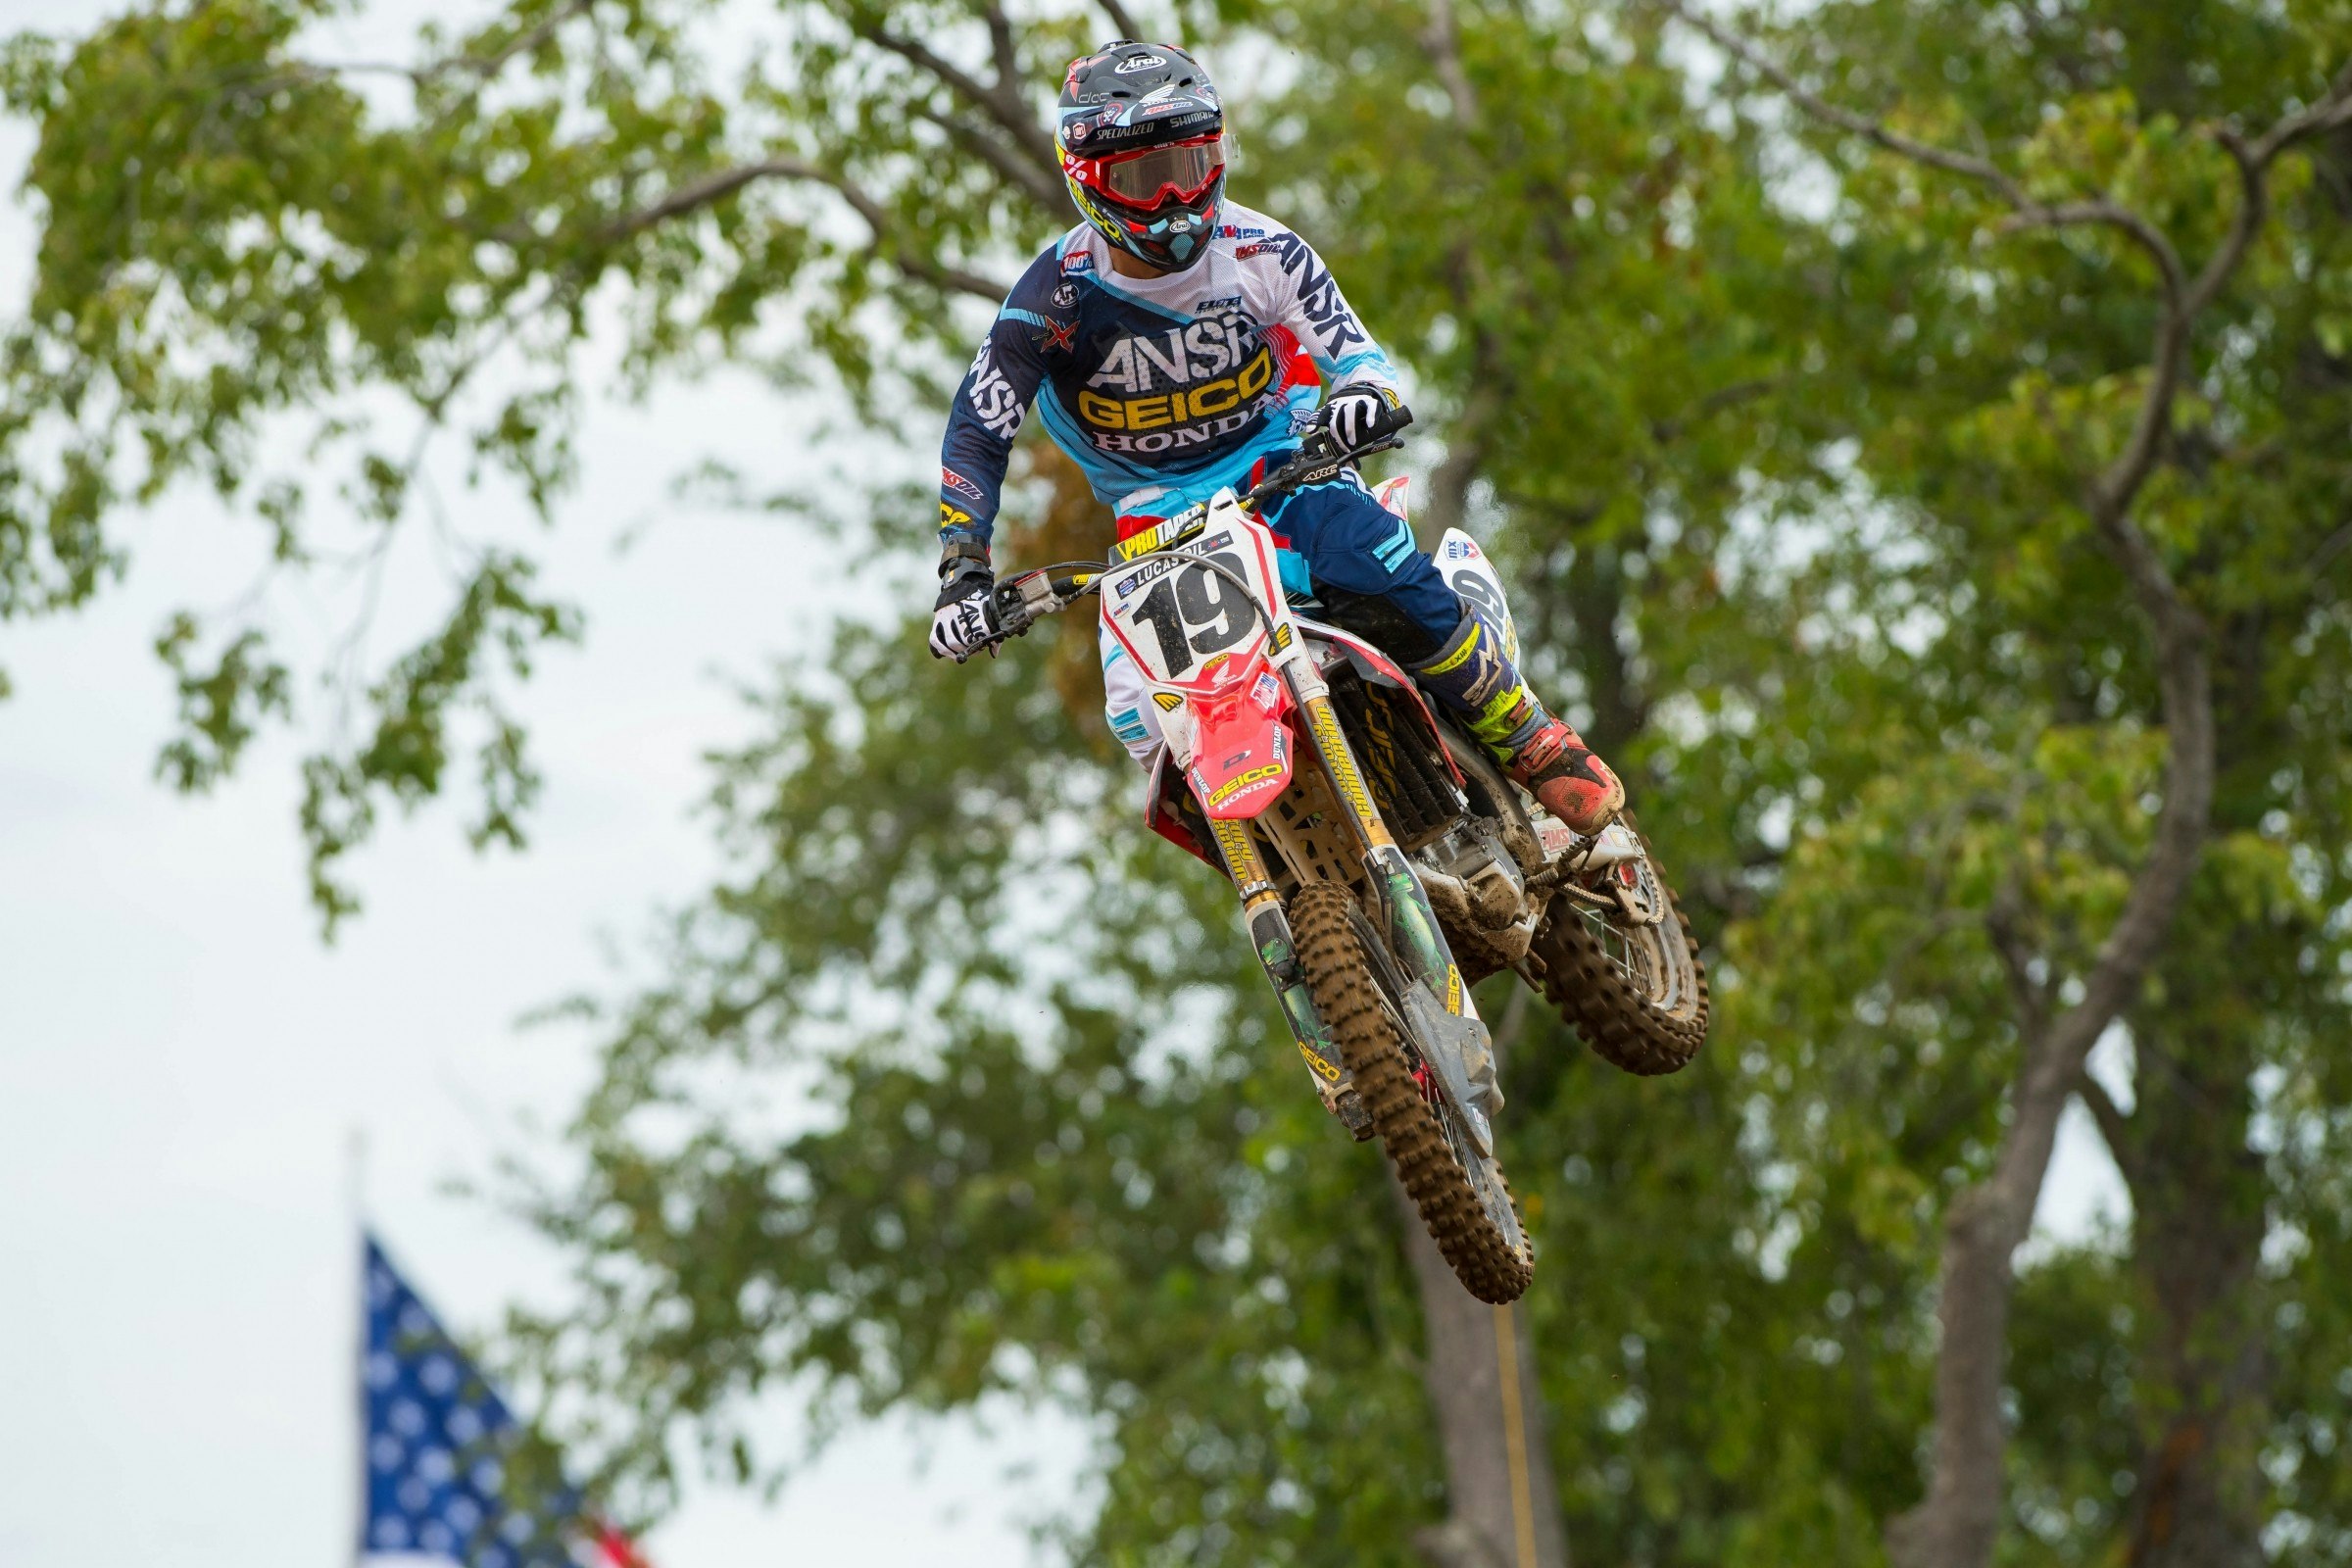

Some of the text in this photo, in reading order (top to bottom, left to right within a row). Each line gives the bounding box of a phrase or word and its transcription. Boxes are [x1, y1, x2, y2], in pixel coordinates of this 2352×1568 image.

[1097, 122, 1154, 140] SPECIALIZED
[1063, 252, 1094, 270] 100%
[1268, 231, 1365, 359] ANSR
[1079, 347, 1272, 430] GEICO
[1094, 392, 1274, 453] HONDA
[1302, 464, 1338, 482] ARC
[1132, 551, 1256, 679] 19
[1204, 654, 1229, 669] GEICO
[1273, 725, 1283, 760] DUNLOP
[1192, 766, 1211, 794] DUNLOP
[1209, 763, 1283, 808] GEICO
[1217, 778, 1279, 812] HONDA
